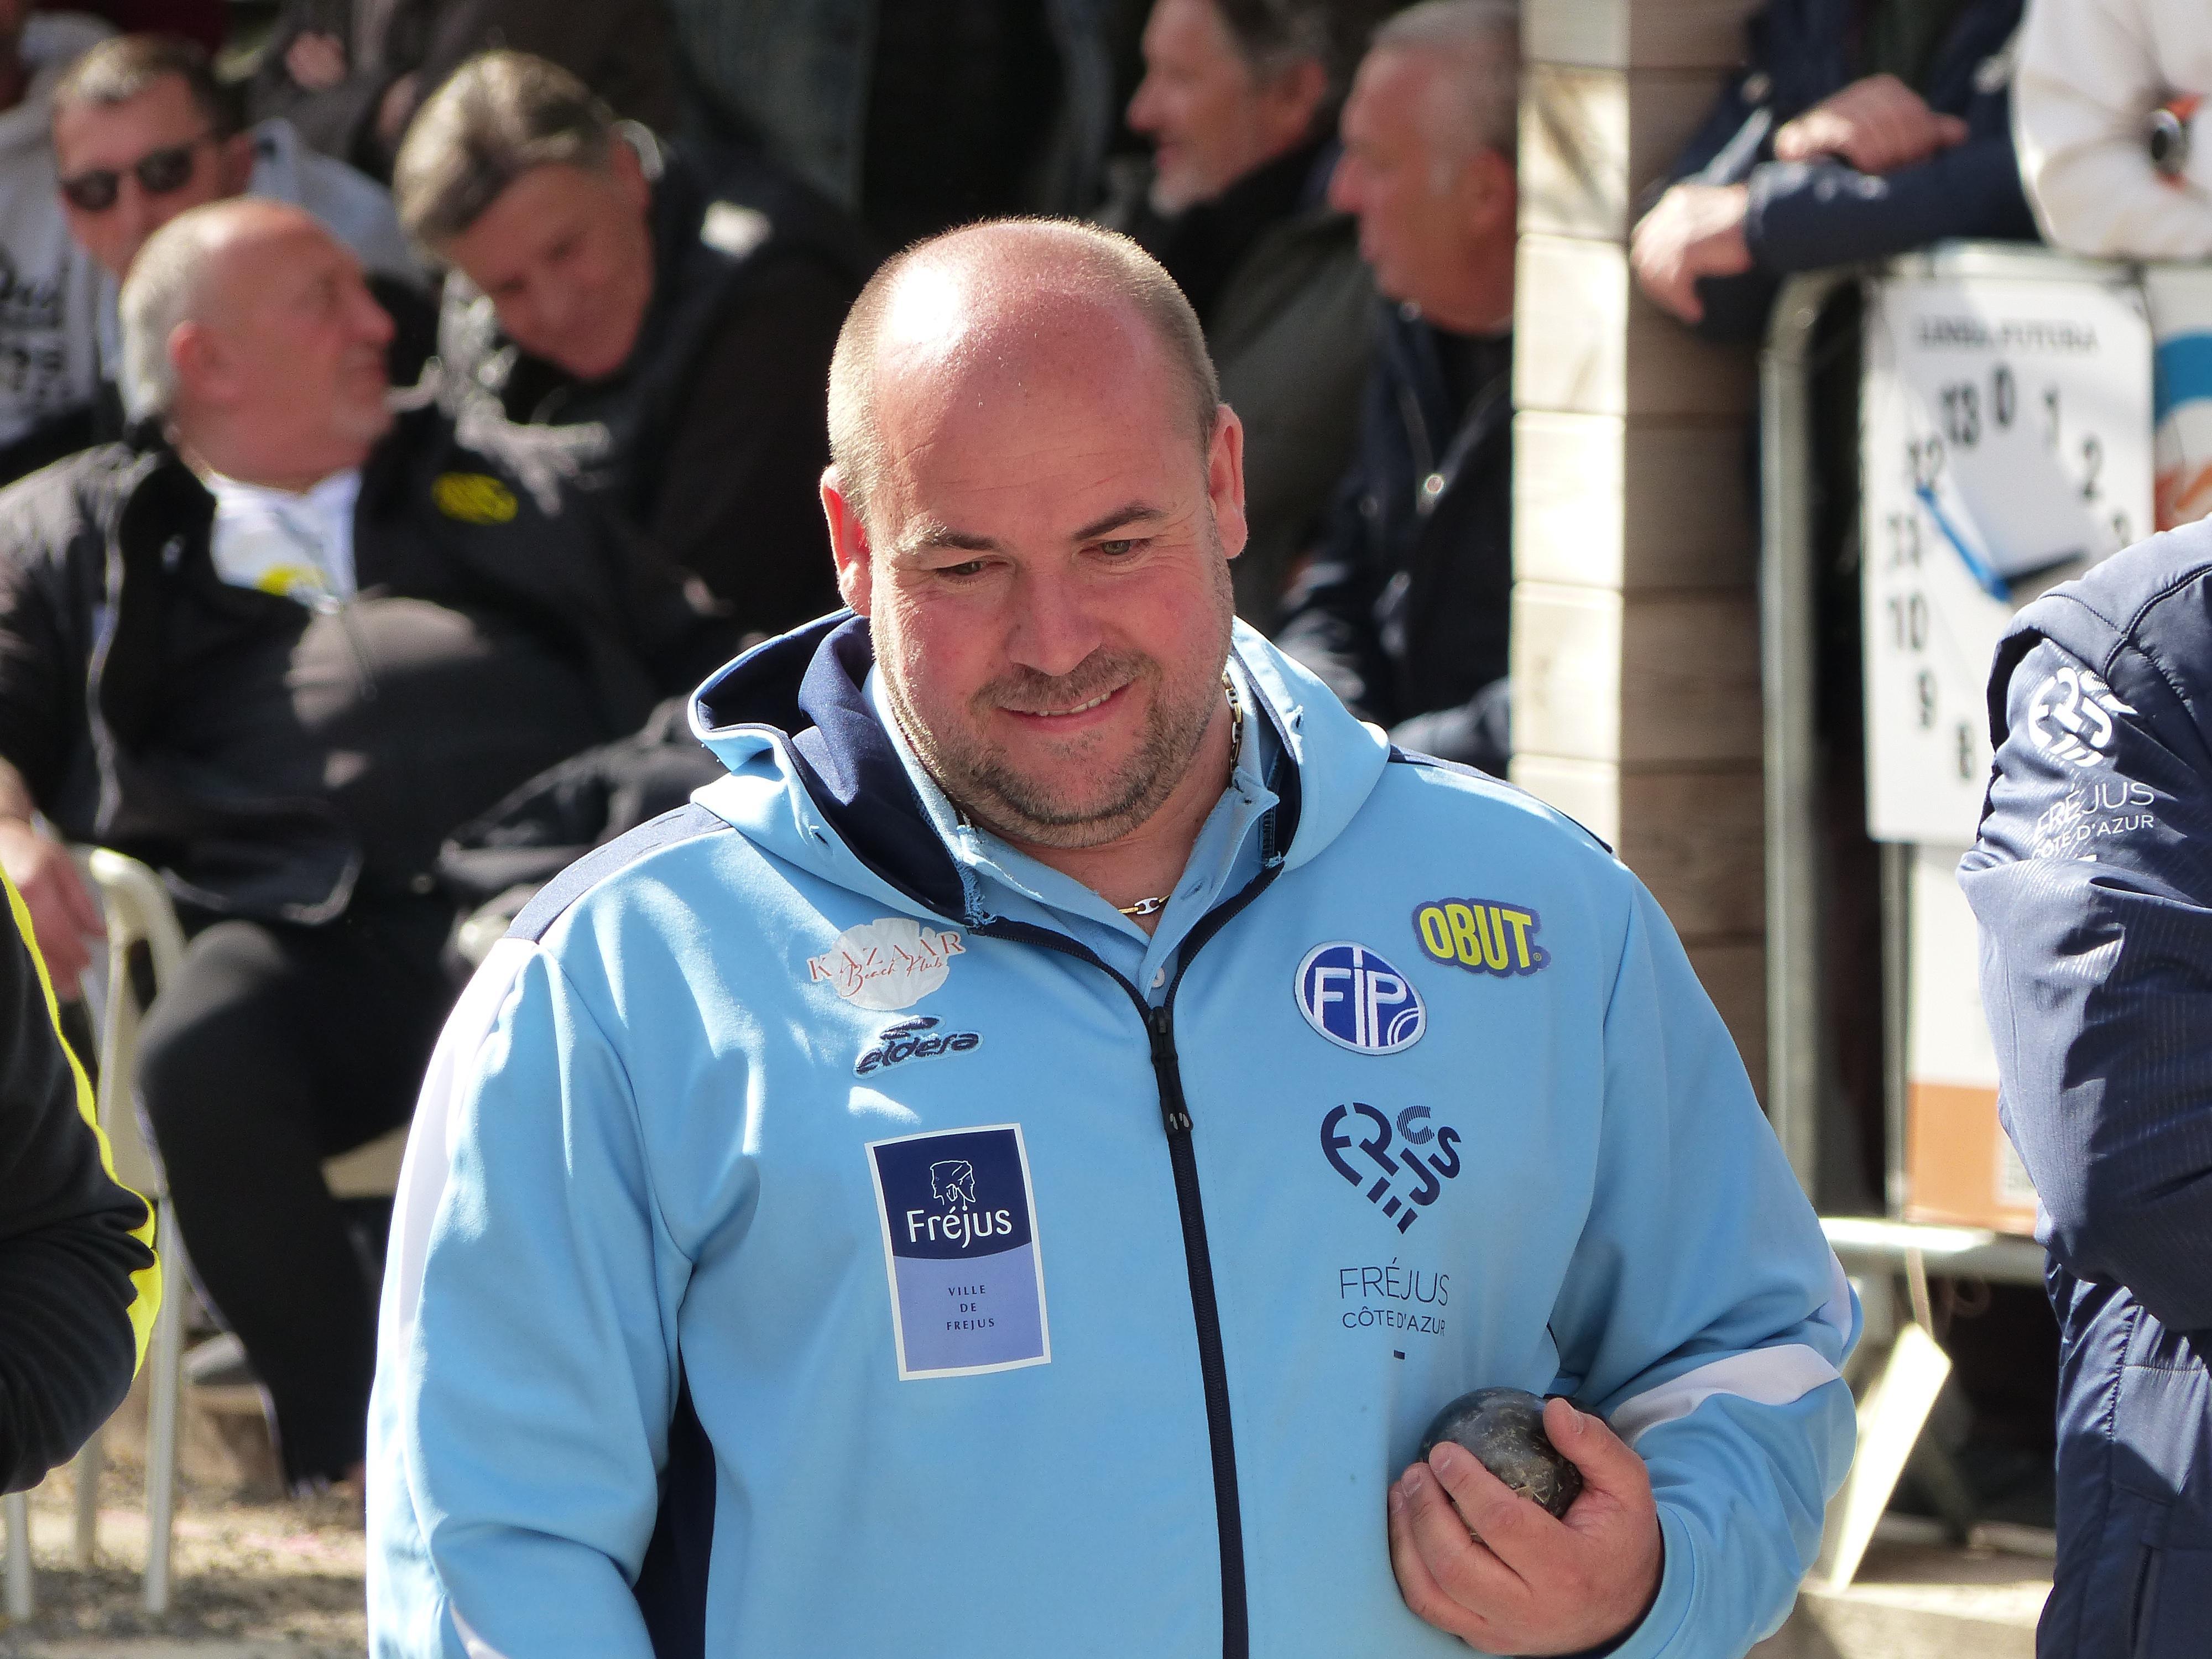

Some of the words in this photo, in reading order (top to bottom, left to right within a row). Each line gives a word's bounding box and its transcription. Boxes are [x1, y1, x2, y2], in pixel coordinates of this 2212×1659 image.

[1994, 364, 2016, 427] 0
[2081, 437, 2103, 502] 2
[1888, 593, 1930, 651] 10
[809, 932, 964, 980] KAZAAR
[839, 961, 897, 997] Beach
[905, 954, 945, 977] Klub
[906, 1206, 1013, 1248] Fréjus
[947, 1284, 987, 1297] VILLE
[1339, 1257, 1449, 1306] FRÉJUS
[946, 1317, 995, 1331] FREJUS
[959, 1302, 977, 1313] DE
[1342, 1306, 1394, 1329] CÔTE
[1397, 1312, 1446, 1337] D'AZUR
